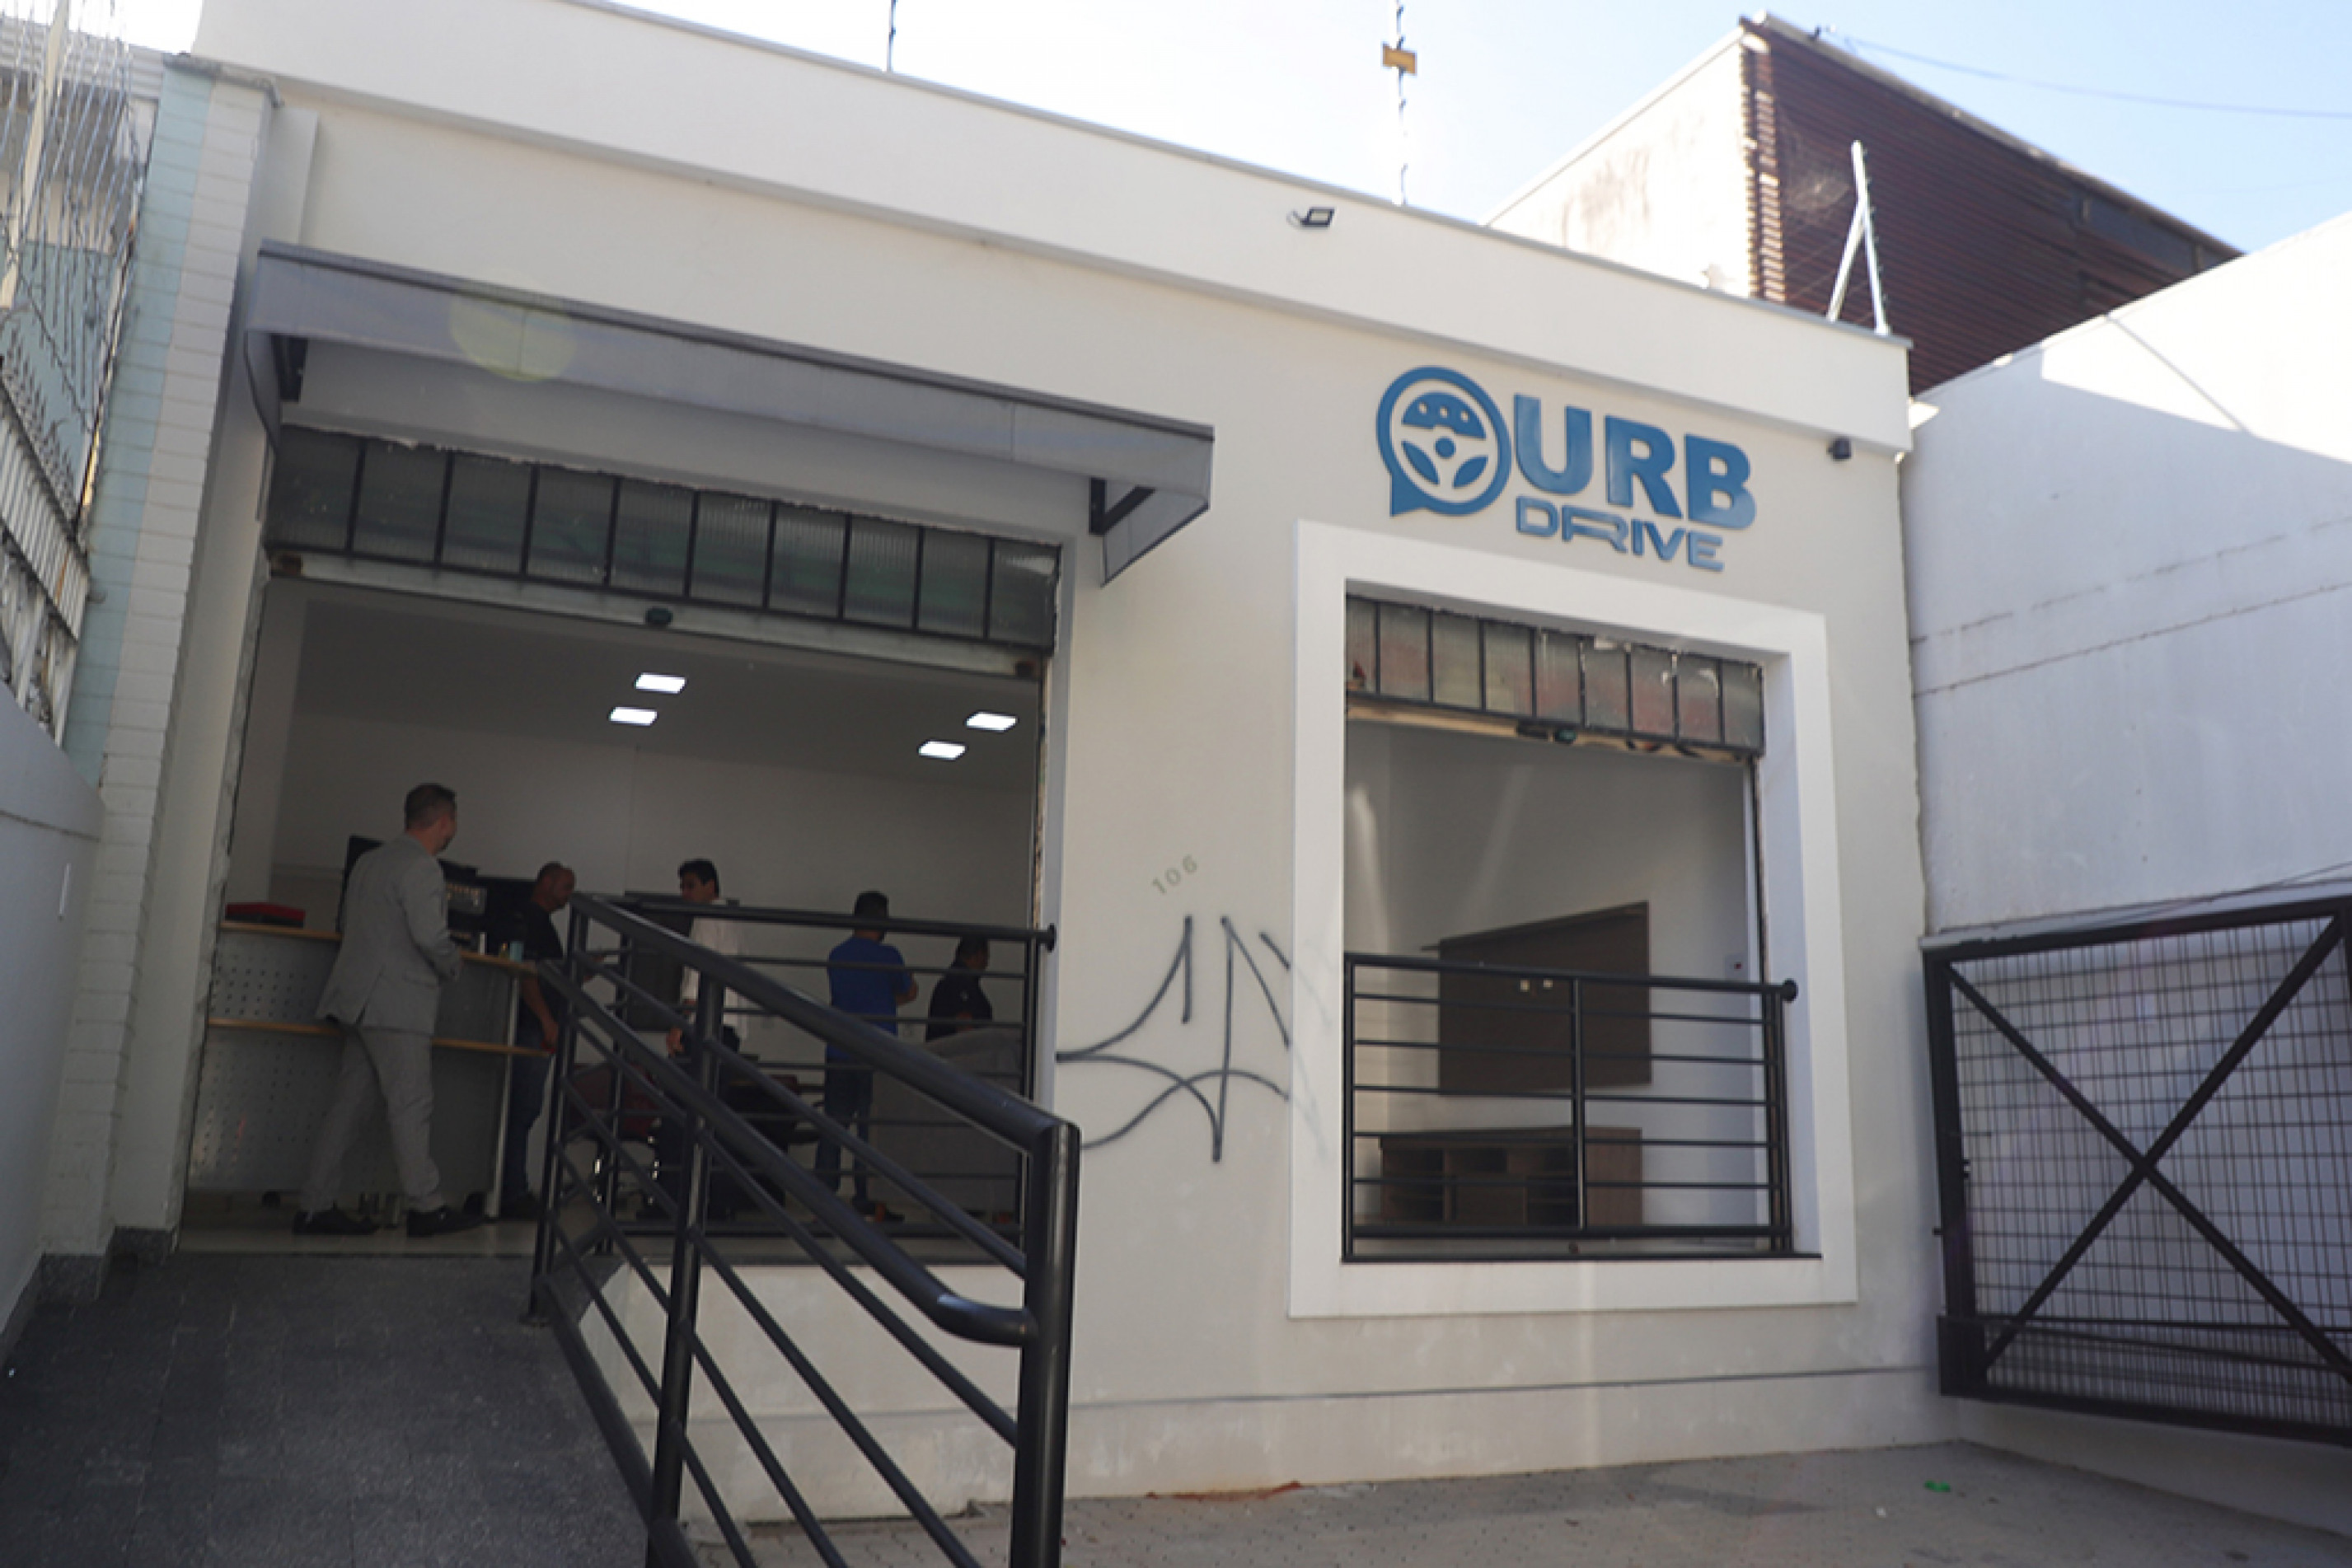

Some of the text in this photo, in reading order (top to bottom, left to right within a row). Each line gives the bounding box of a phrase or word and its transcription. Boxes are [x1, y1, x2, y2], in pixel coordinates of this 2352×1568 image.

[1514, 393, 1756, 530] URB
[1516, 496, 1724, 571] DRIVE
[1151, 854, 1198, 895] 106
